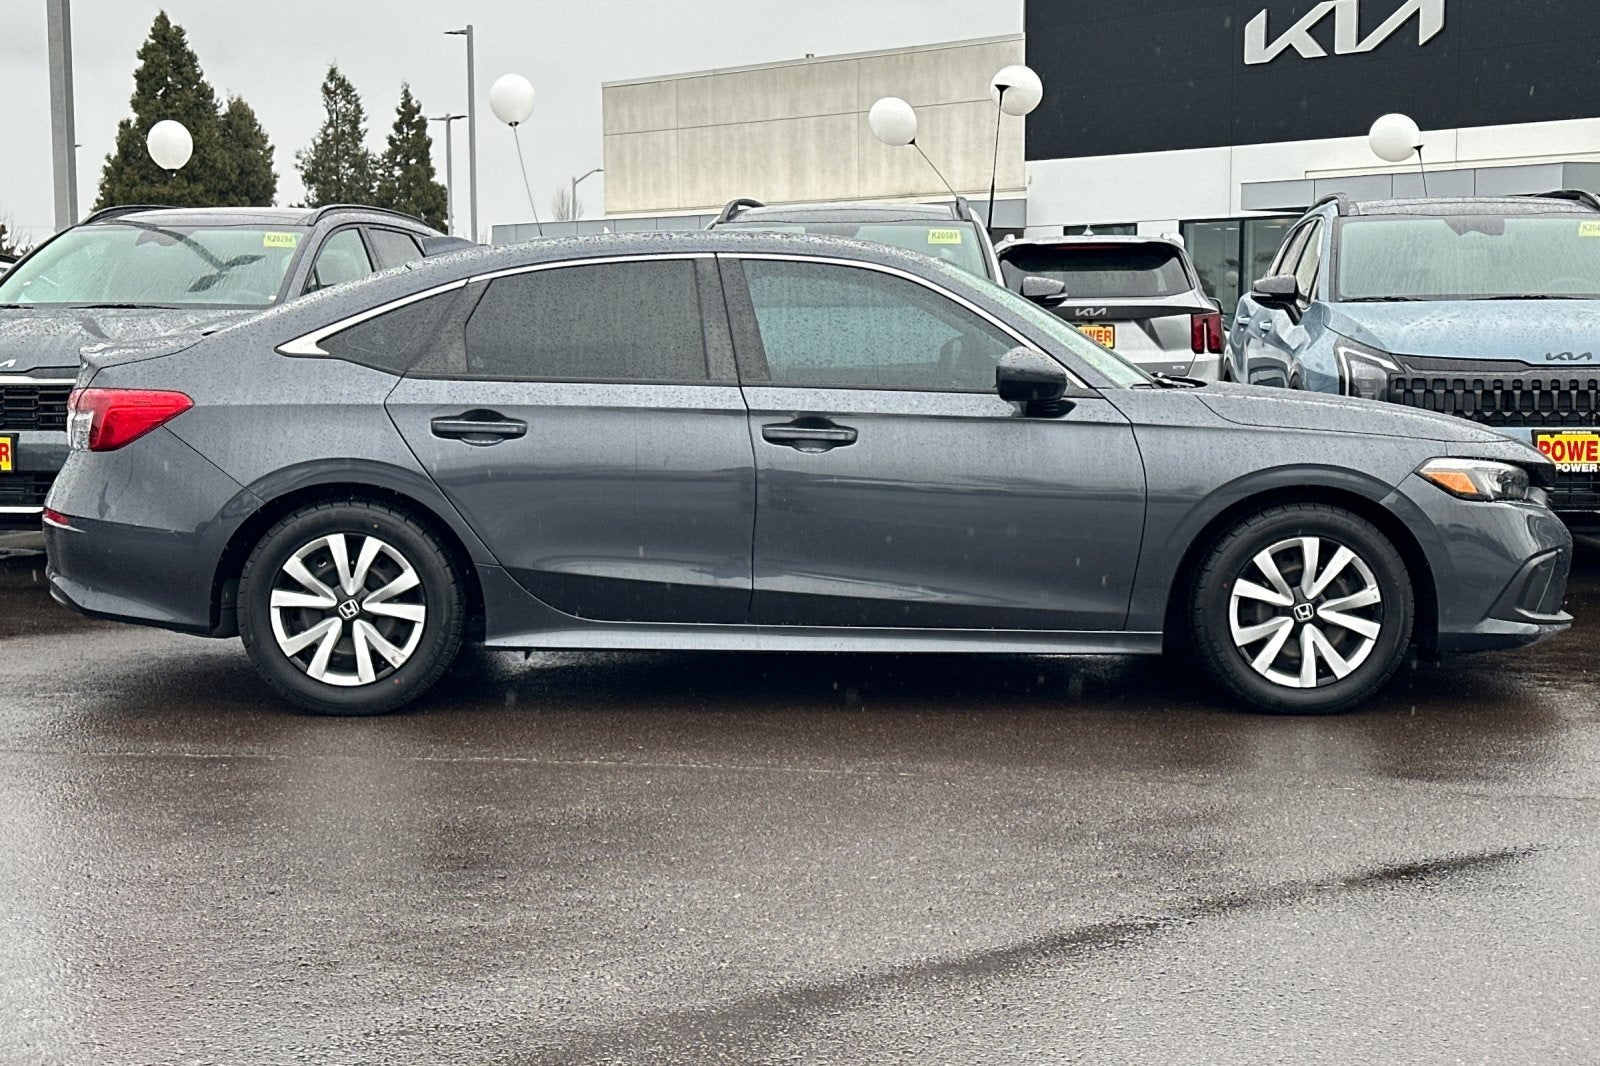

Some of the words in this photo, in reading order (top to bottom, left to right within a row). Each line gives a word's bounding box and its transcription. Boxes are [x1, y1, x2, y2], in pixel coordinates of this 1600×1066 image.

[1244, 0, 1445, 64] KIA
[1075, 308, 1107, 317] KIA
[1545, 352, 1593, 361] KIA
